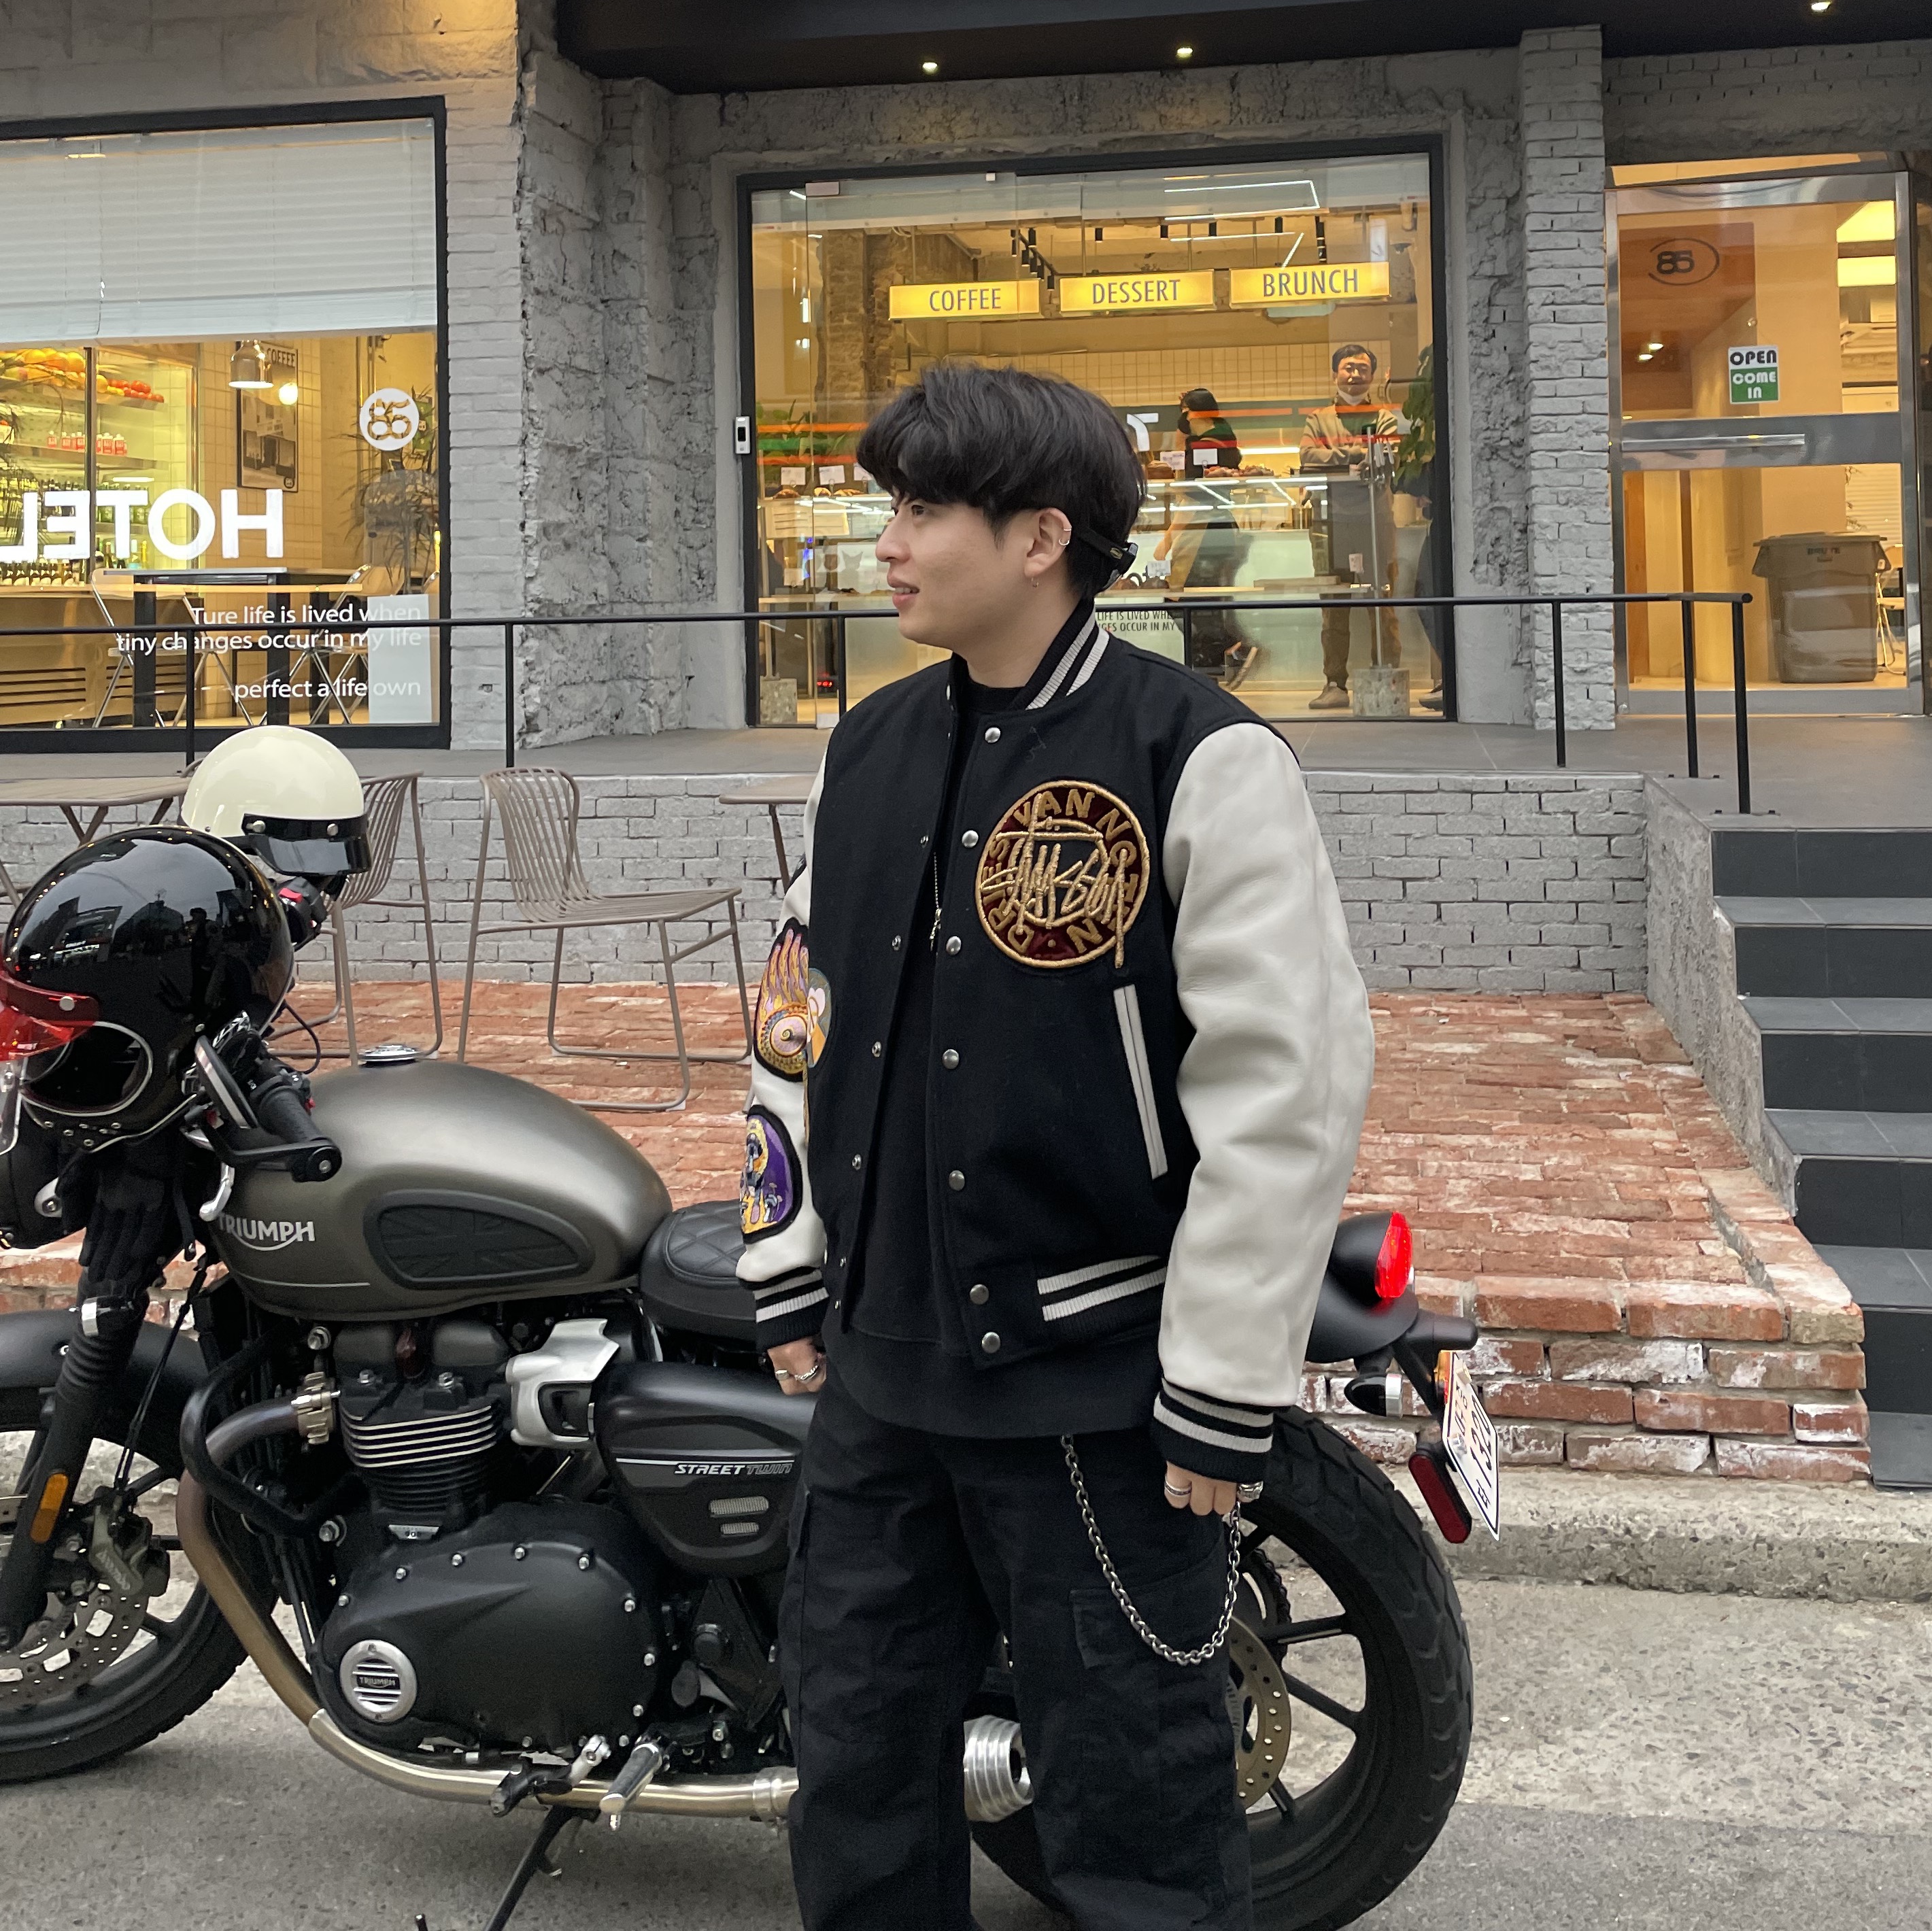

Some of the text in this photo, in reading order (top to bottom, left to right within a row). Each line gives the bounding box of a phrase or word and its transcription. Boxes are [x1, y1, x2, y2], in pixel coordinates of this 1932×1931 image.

[1092, 279, 1181, 304] DESSERT
[1263, 269, 1358, 297] BRUNCH
[929, 288, 1002, 312] COFFEE
[1730, 350, 1777, 365] OPEN
[1733, 371, 1776, 385] COME
[1748, 386, 1762, 399] IN
[191, 603, 420, 625] Ture life is lived when
[1117, 612, 1124, 620] IS
[1128, 611, 1149, 620] LIVED
[1120, 622, 1147, 632] OCCUR
[1151, 622, 1159, 631] IN
[1163, 621, 1175, 631] MY
[116, 633, 156, 655] tiny
[258, 634, 319, 649] occur
[324, 630, 343, 647] in
[350, 632, 384, 651] my
[391, 627, 422, 646] life
[235, 678, 420, 703] perfect a life own
[1013, 789, 1095, 827] VAN
[218, 1212, 316, 1246] TRIUMPH
[1470, 1395, 1491, 1488] 1320
[675, 1464, 793, 1475] STREET TWIN
